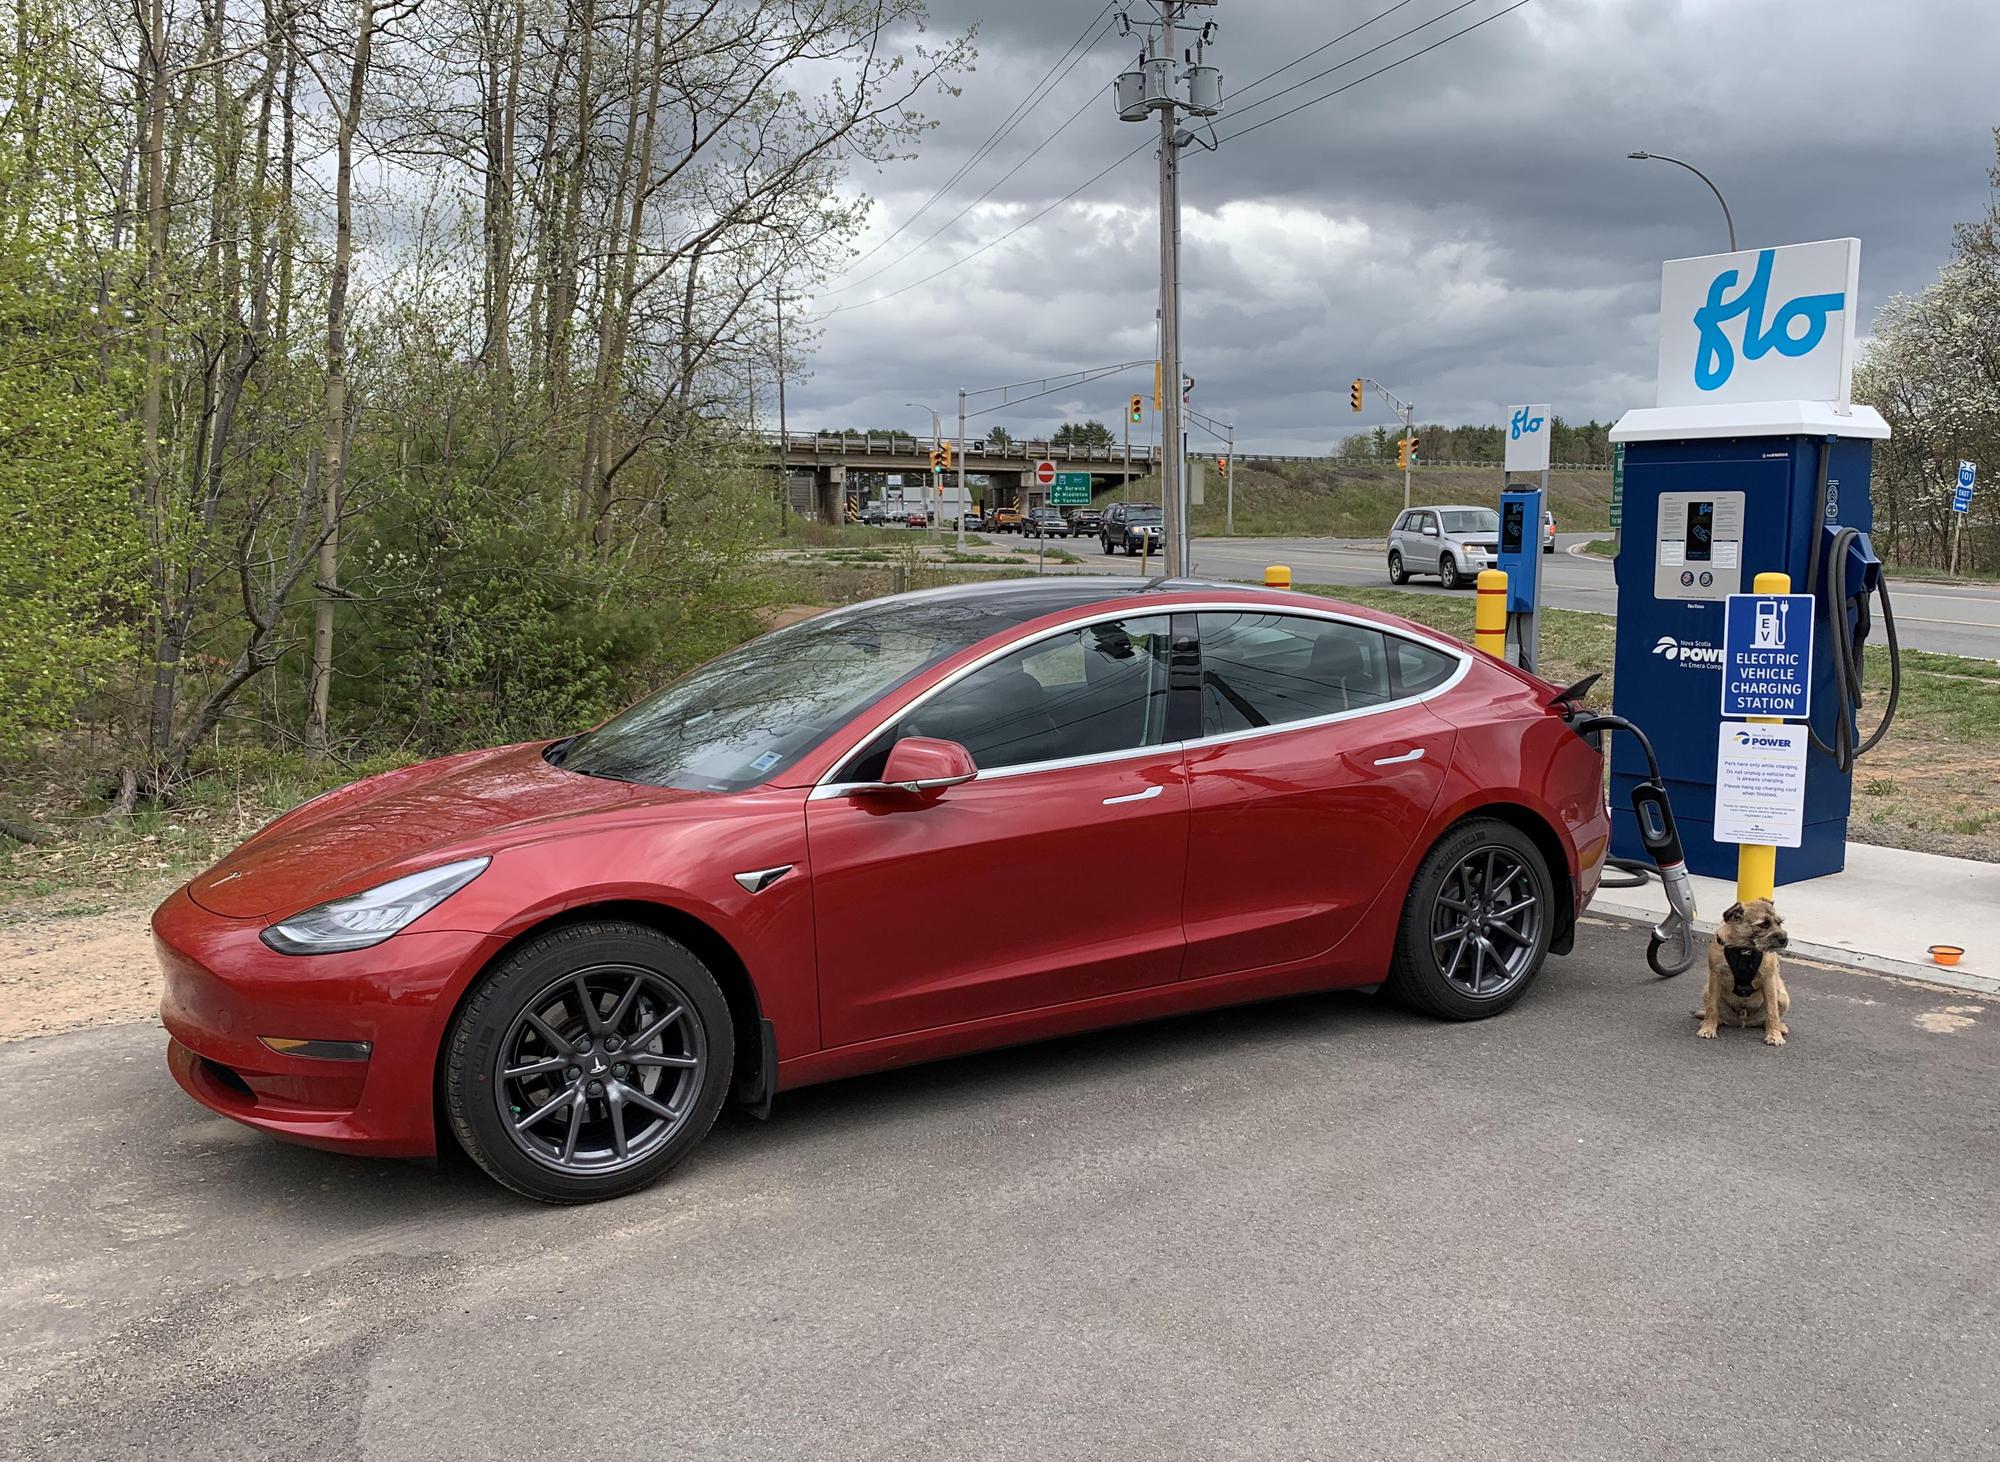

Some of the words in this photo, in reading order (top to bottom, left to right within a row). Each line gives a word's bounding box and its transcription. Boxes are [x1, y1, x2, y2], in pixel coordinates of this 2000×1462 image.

[1693, 249, 1845, 391] flo
[1512, 406, 1544, 440] flo
[1961, 471, 1973, 481] 101
[1958, 489, 1970, 497] EAST
[1680, 648, 1725, 662] POWE
[1736, 653, 1799, 665] ELECTRIC
[1706, 663, 1724, 671] Comp
[1740, 668, 1794, 680] VEHICLE
[1731, 682, 1801, 695] CHARGING
[1737, 697, 1794, 709] STATION
[1752, 738, 1791, 747] POWER
